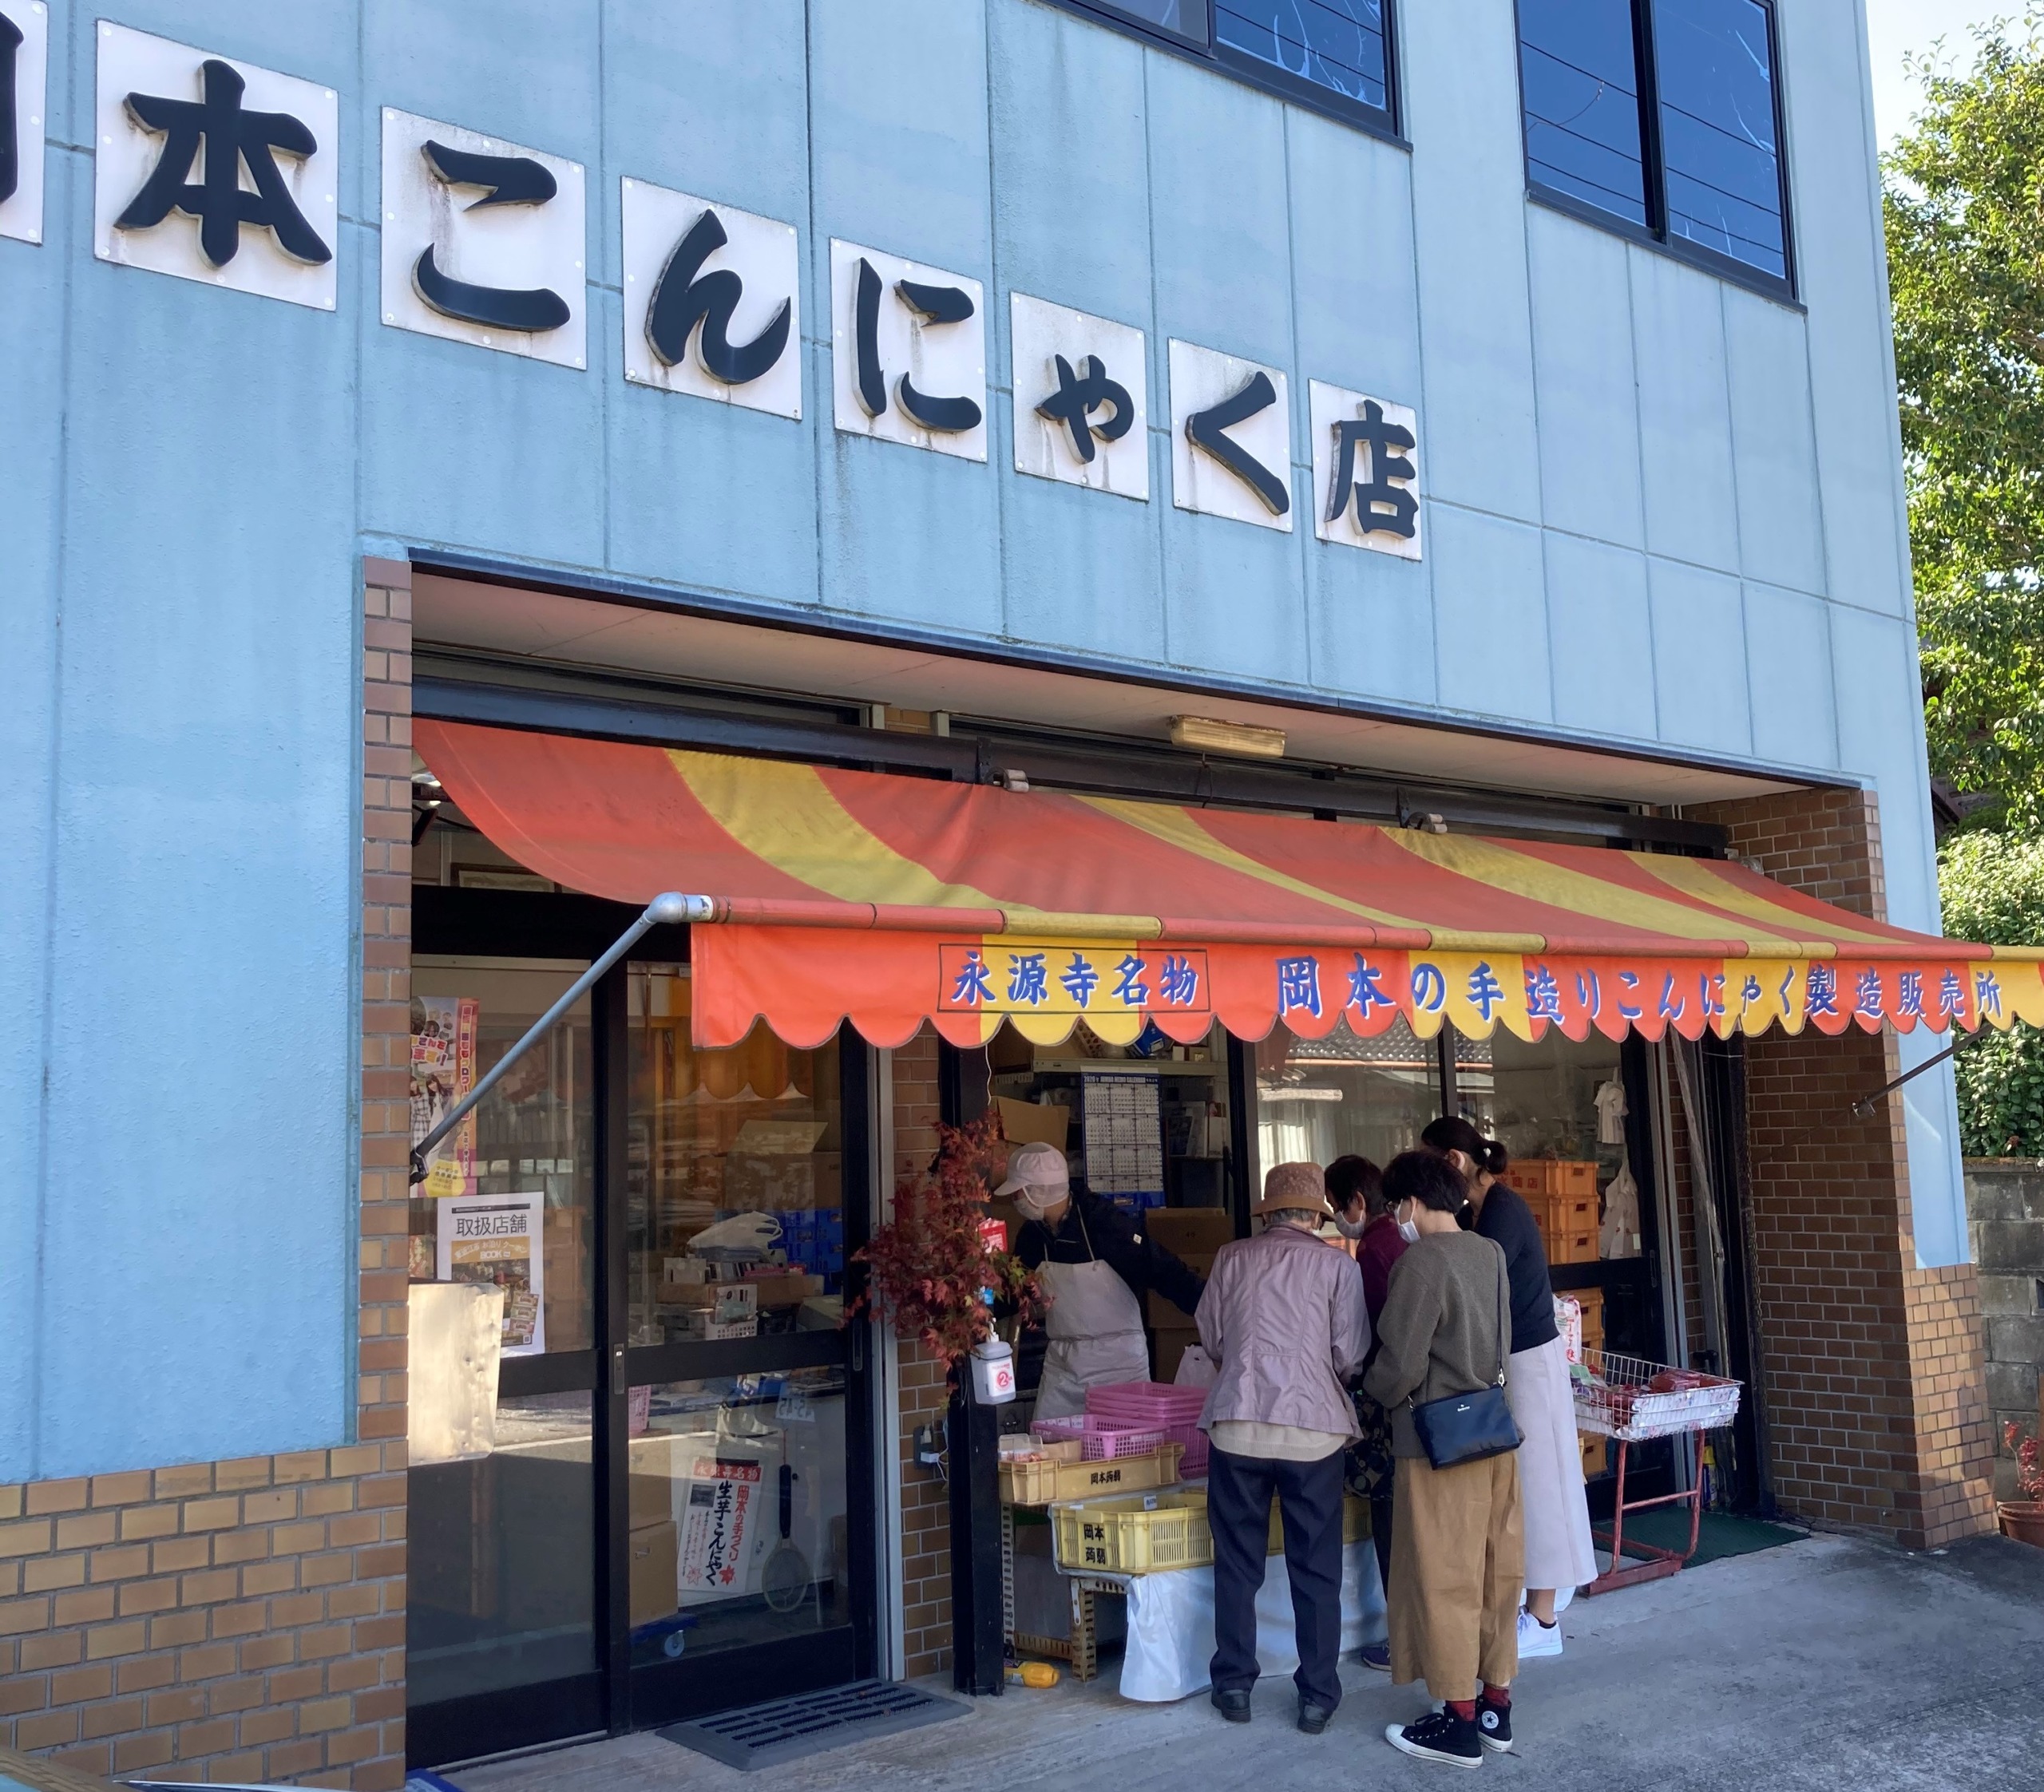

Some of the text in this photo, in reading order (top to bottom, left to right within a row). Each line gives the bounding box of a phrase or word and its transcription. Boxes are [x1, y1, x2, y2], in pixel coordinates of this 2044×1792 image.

[0, 11, 1419, 539] 本こんにゃく店
[951, 951, 2003, 1026] 永源寺名物 岡本の手造りこんにゃく製造販売所
[456, 1213, 528, 1236] 取扱店舗
[1083, 1523, 1105, 1542] 岡本
